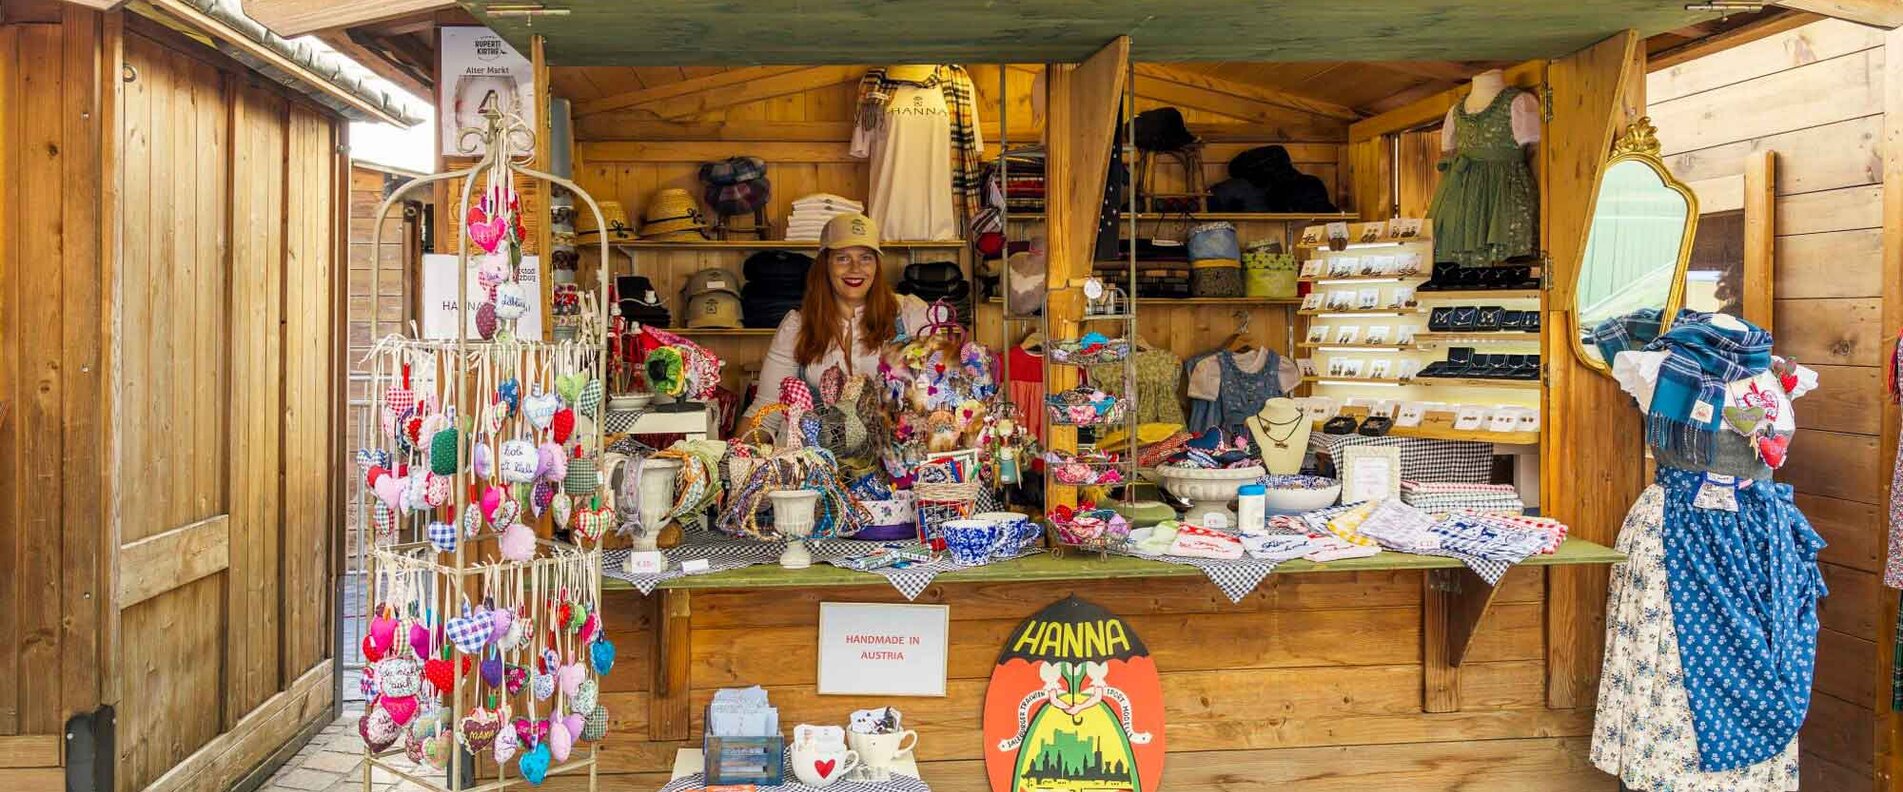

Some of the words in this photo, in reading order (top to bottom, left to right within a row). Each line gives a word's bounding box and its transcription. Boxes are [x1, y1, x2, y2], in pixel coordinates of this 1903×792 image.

[466, 66, 484, 74] Alter
[487, 66, 509, 74] Markt
[890, 107, 948, 116] HANNA
[846, 635, 905, 645] HANDMADE
[909, 636, 920, 645] IN
[1013, 619, 1131, 658] HANNA
[860, 651, 904, 660] AUSTRIA
